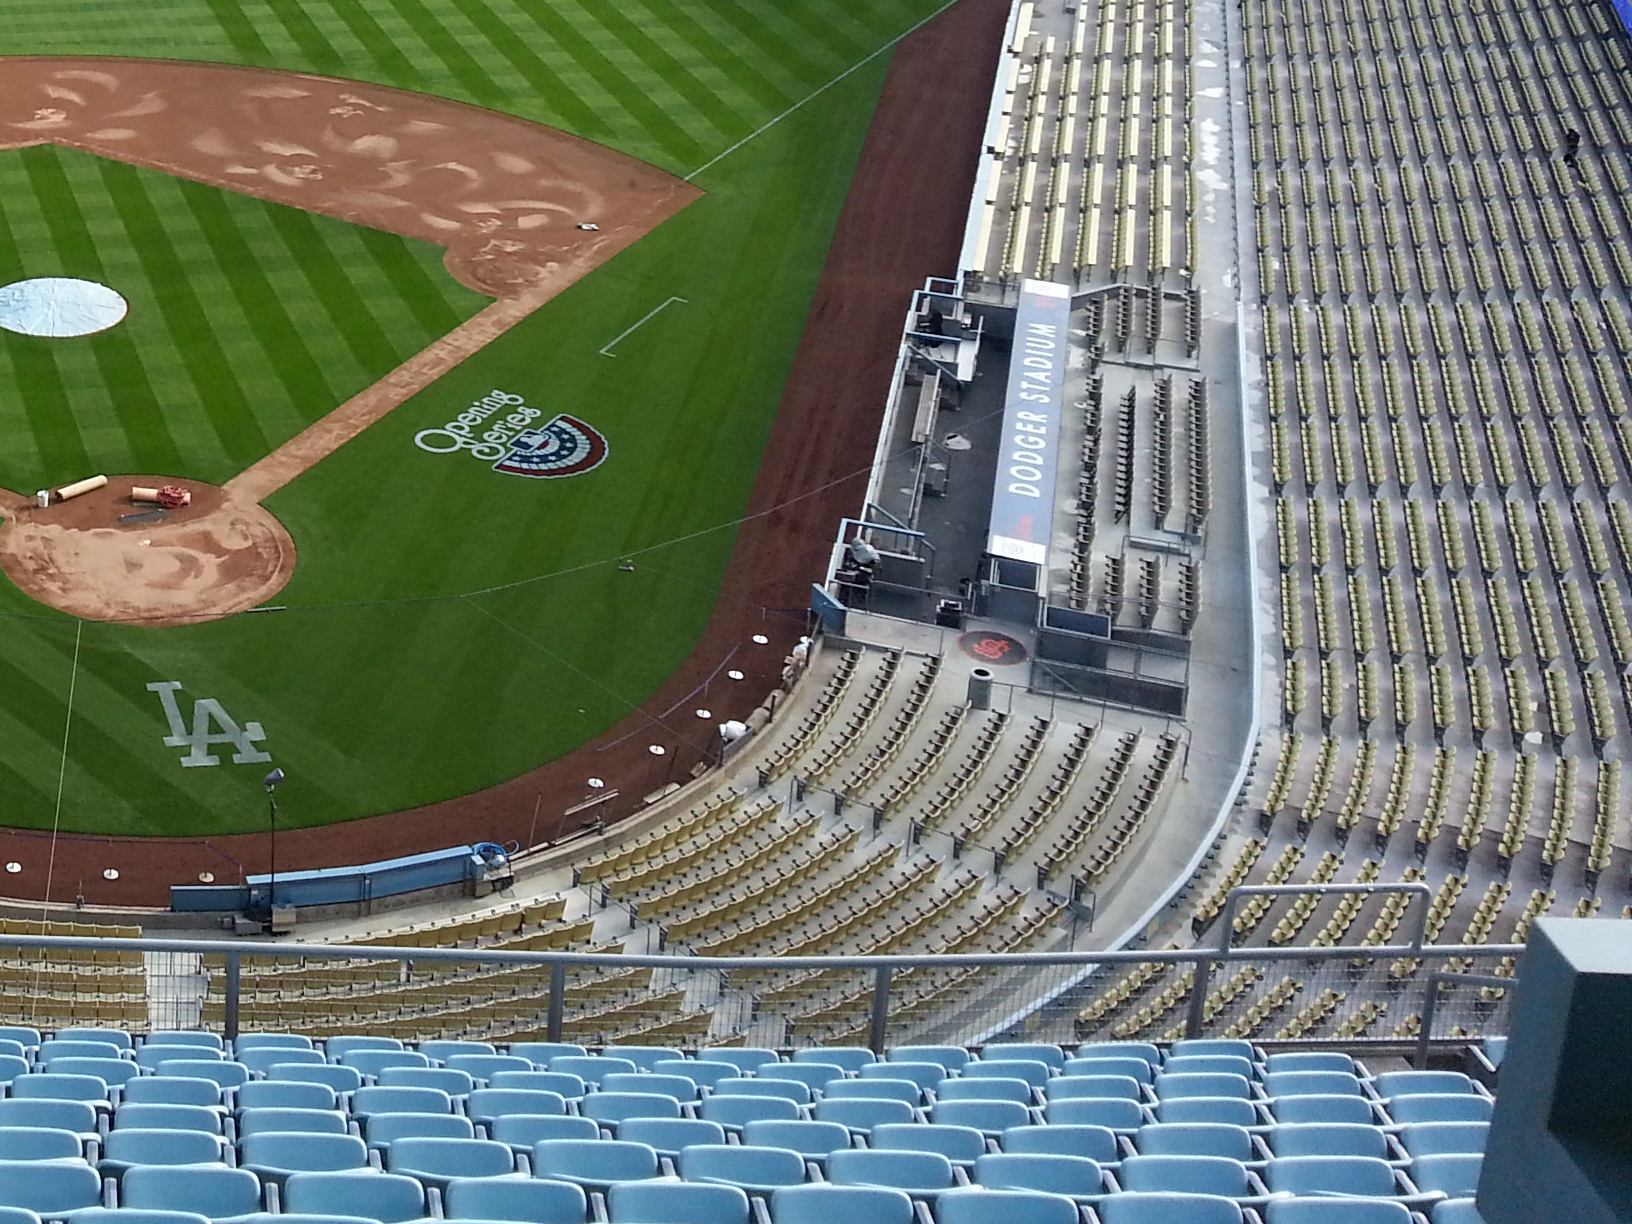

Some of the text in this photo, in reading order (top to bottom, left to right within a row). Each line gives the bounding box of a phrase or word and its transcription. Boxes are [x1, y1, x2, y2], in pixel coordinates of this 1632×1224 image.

[1020, 323, 1056, 404] STADIUM
[414, 389, 524, 453] Opening
[462, 406, 541, 460] Series
[1008, 409, 1047, 498] DODGER
[146, 681, 272, 767] LA
